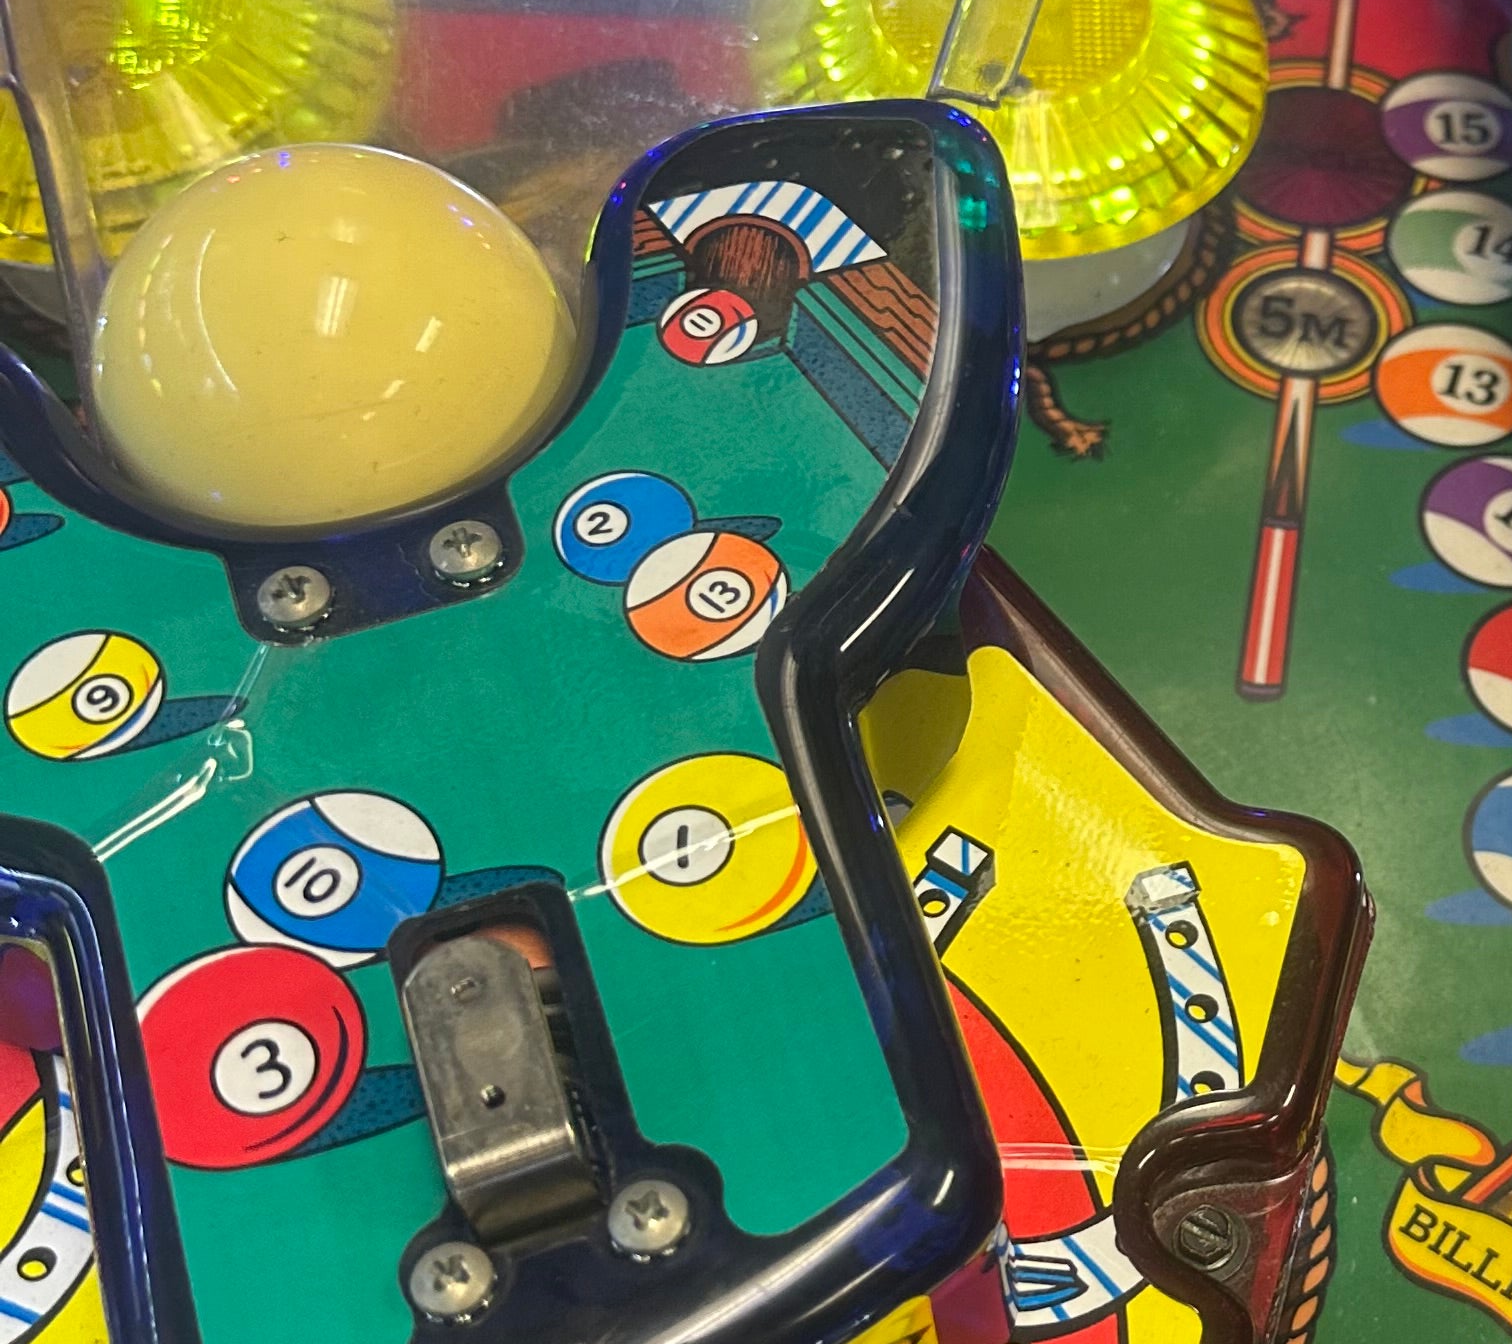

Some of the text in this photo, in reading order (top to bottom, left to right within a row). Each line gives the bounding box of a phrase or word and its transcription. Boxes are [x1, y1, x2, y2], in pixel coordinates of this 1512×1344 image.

[1436, 113, 1490, 146] 15
[1258, 297, 1347, 348] 5M
[1443, 363, 1499, 406] 13
[587, 511, 613, 536] 2
[698, 578, 742, 612] 13
[88, 685, 119, 715] 9
[282, 857, 337, 906] 10
[239, 1038, 292, 1099] 3
